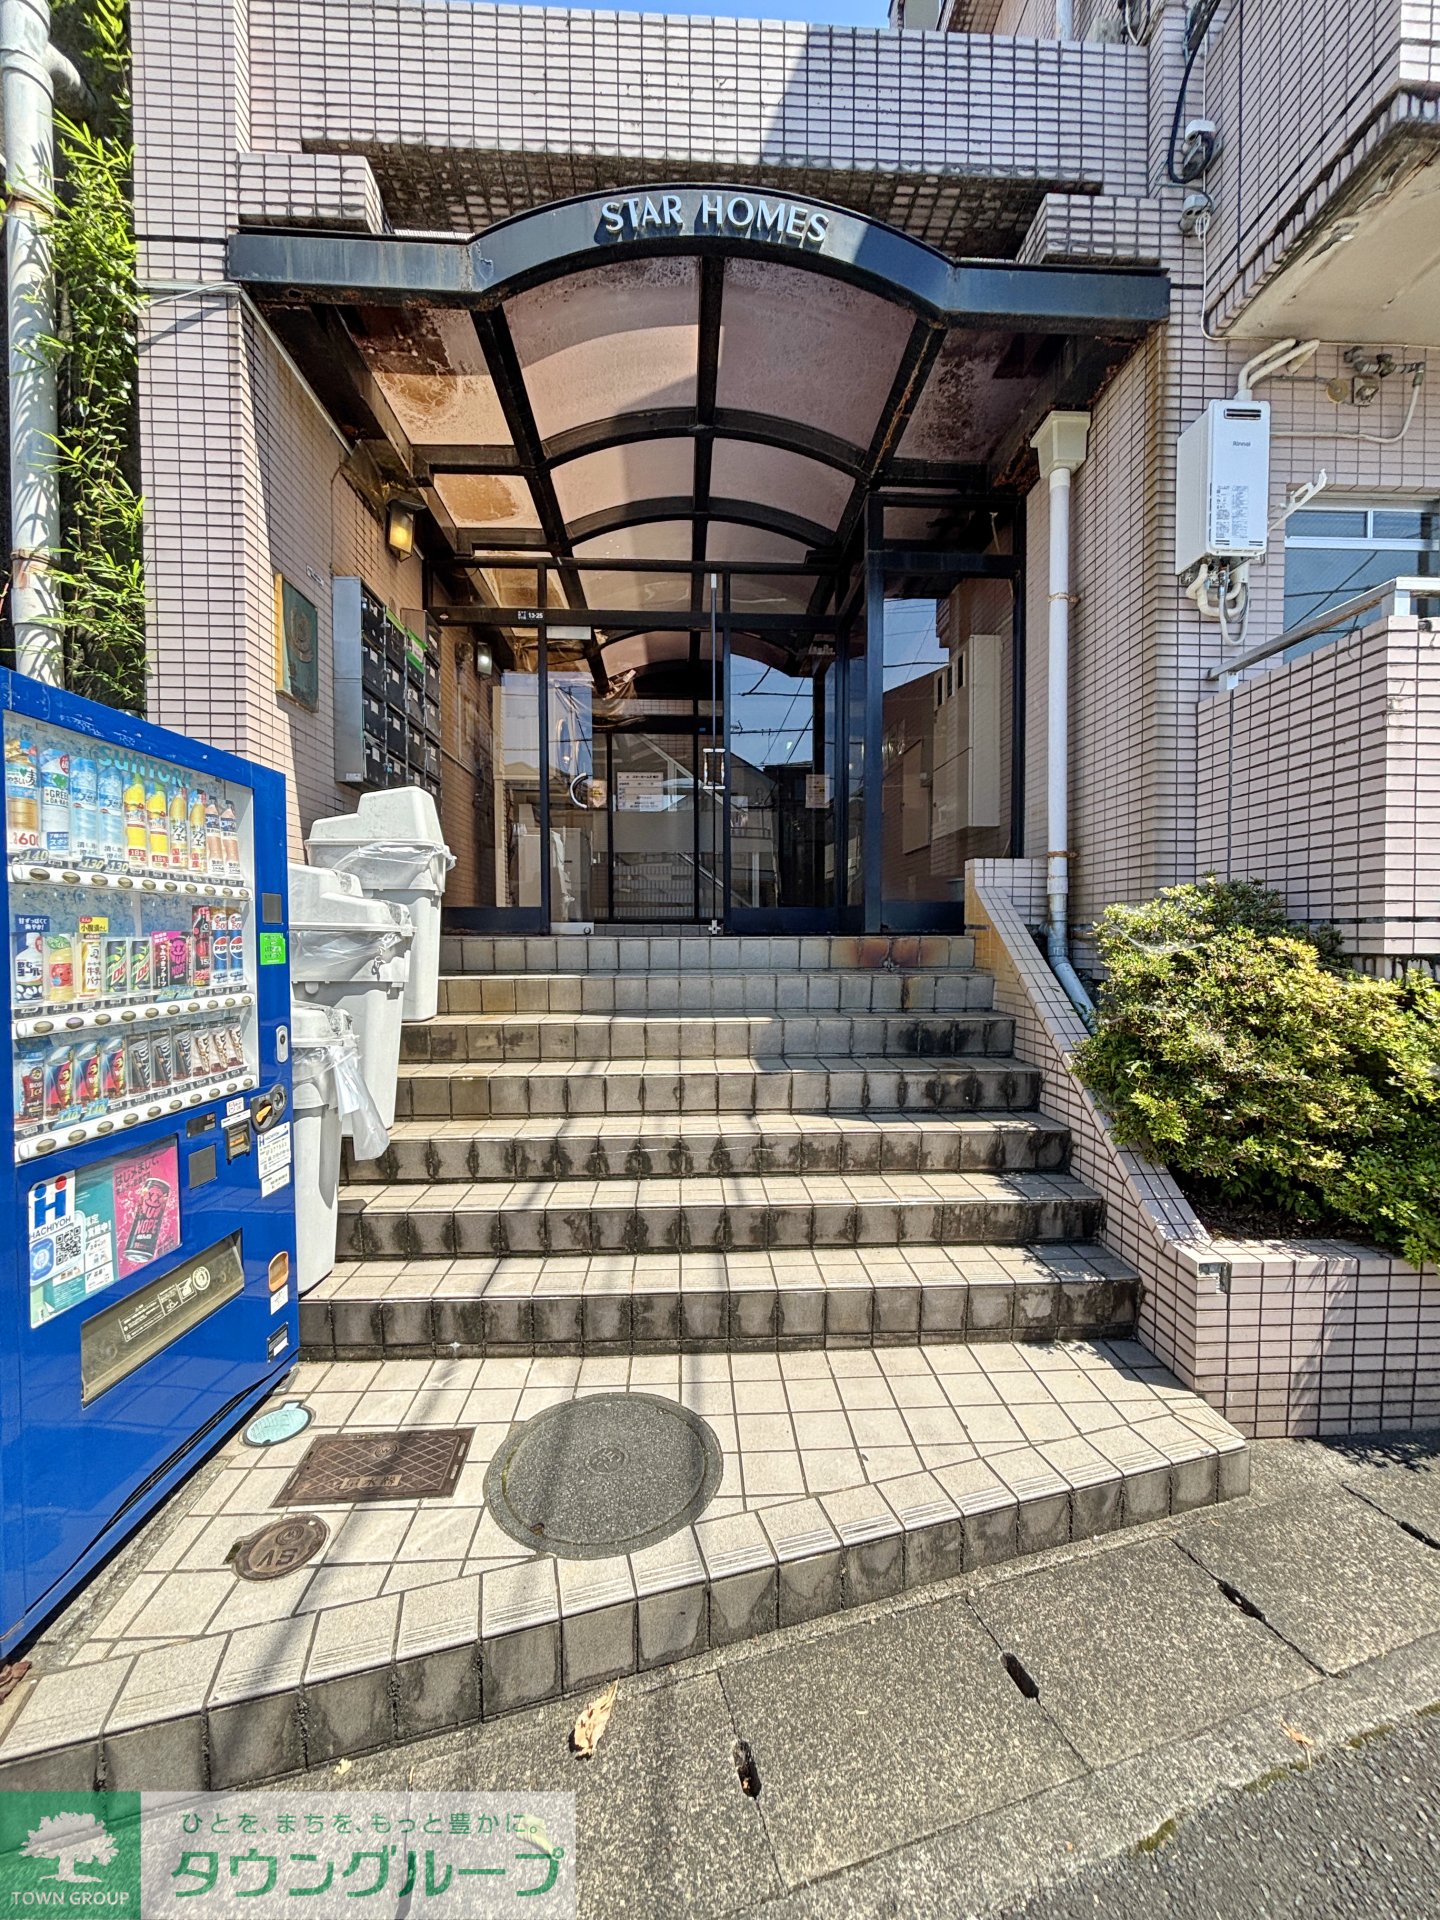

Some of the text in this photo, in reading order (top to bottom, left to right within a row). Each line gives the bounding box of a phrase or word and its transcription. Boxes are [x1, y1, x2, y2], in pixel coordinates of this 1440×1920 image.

[601, 195, 829, 242] STAR HOMES
[98, 745, 192, 788] SUNTORY
[84, 858, 105, 869] 130
[109, 860, 129, 872] 130
[29, 1216, 72, 1239] HACHIYOH
[135, 1219, 157, 1234] NOPE
